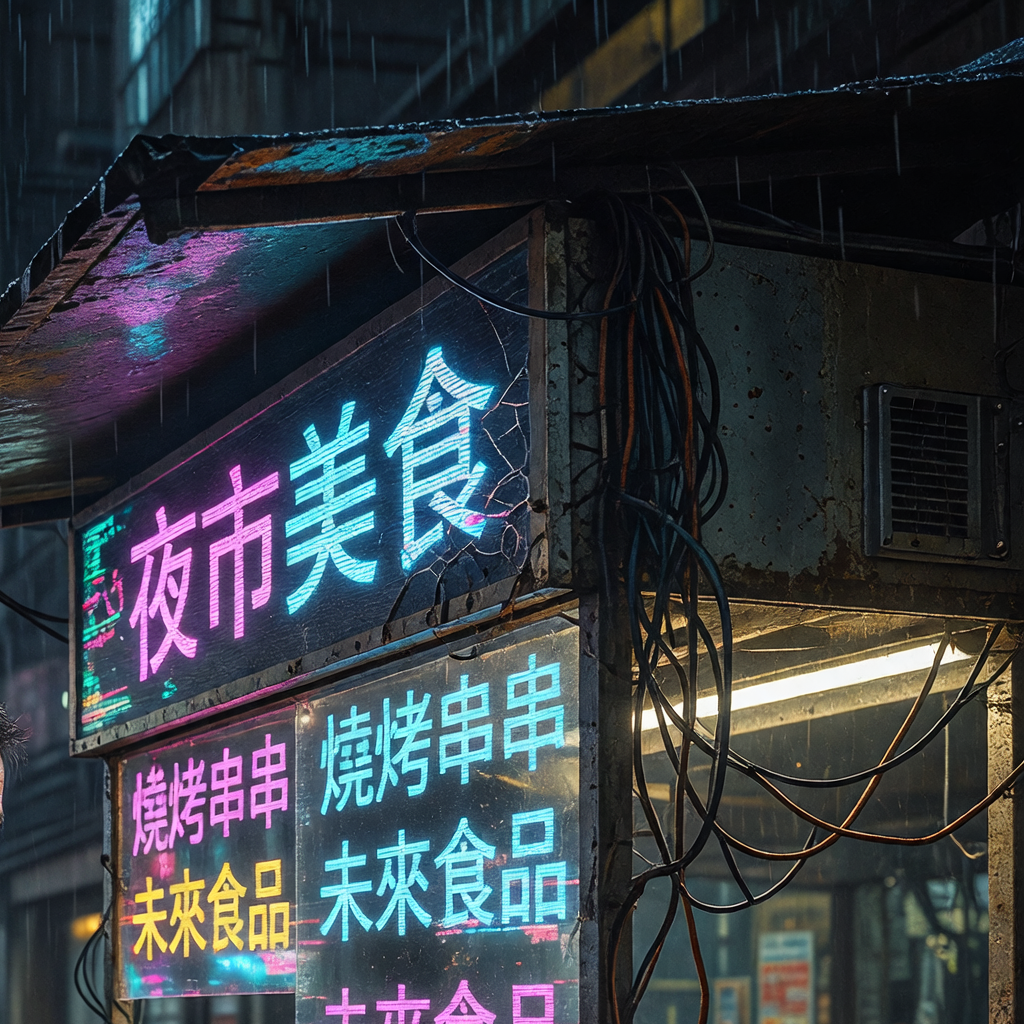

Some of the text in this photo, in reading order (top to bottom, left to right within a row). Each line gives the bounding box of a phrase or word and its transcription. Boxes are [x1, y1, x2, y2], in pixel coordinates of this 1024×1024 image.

[129, 347, 494, 682] 夜市美食
[132, 734, 289, 856] 燒烤串串
[320, 654, 565, 815] 燒烤串串
[133, 859, 290, 961] 未來食品
[319, 806, 568, 942] 未來食品
